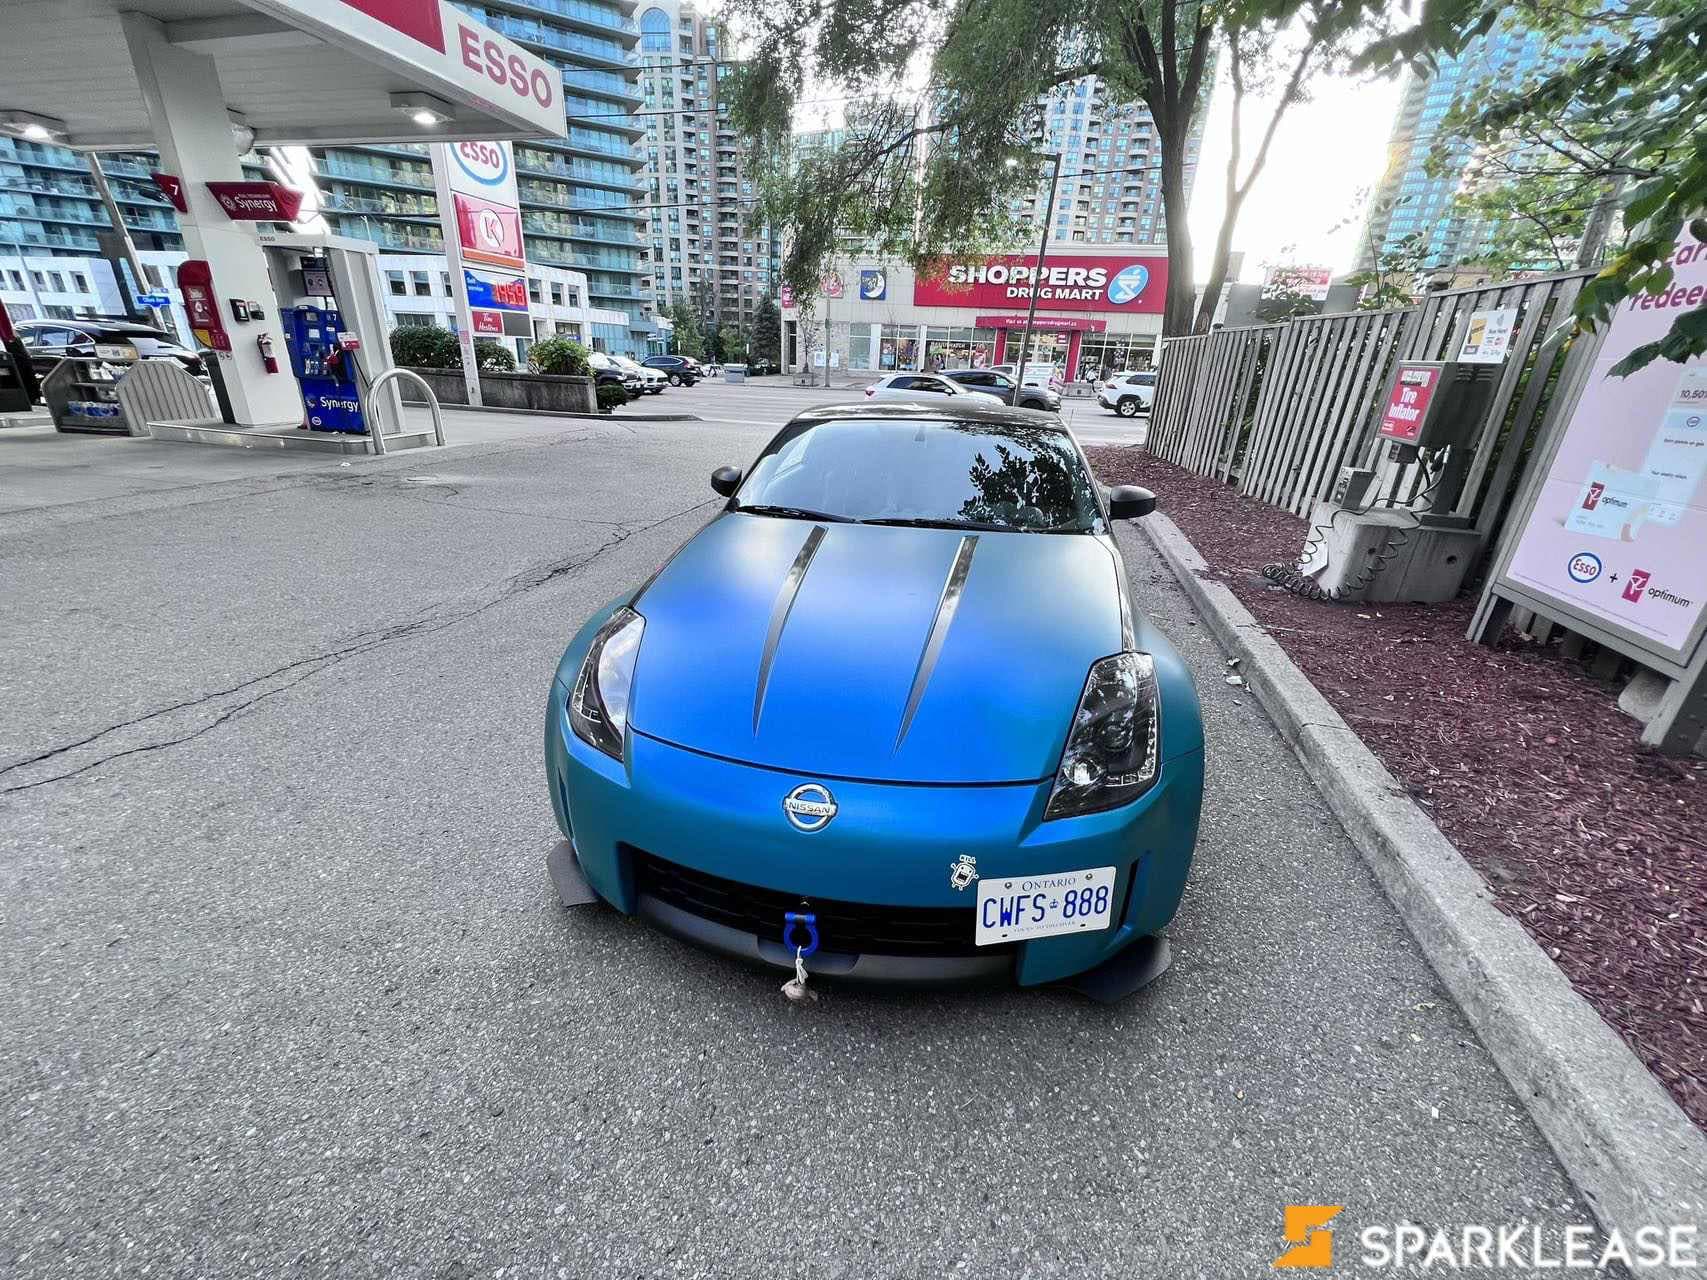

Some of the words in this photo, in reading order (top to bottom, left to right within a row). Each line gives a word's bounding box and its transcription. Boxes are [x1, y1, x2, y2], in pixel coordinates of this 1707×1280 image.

[458, 23, 552, 108] ESSO
[170, 184, 178, 195] 7
[234, 196, 278, 212] Synergy
[949, 265, 1108, 288] SHOPPERS
[1055, 288, 1103, 300] MART
[1630, 281, 1707, 311] redee
[1400, 387, 1418, 404] Tire
[1388, 403, 1420, 421] Inflator
[1602, 496, 1628, 508] optimum
[1648, 586, 1690, 608] optimum
[789, 801, 830, 814] NISSAN
[1022, 877, 1076, 892] ONTARIO
[982, 893, 1047, 929] CWFS
[1062, 885, 1109, 919] 888
